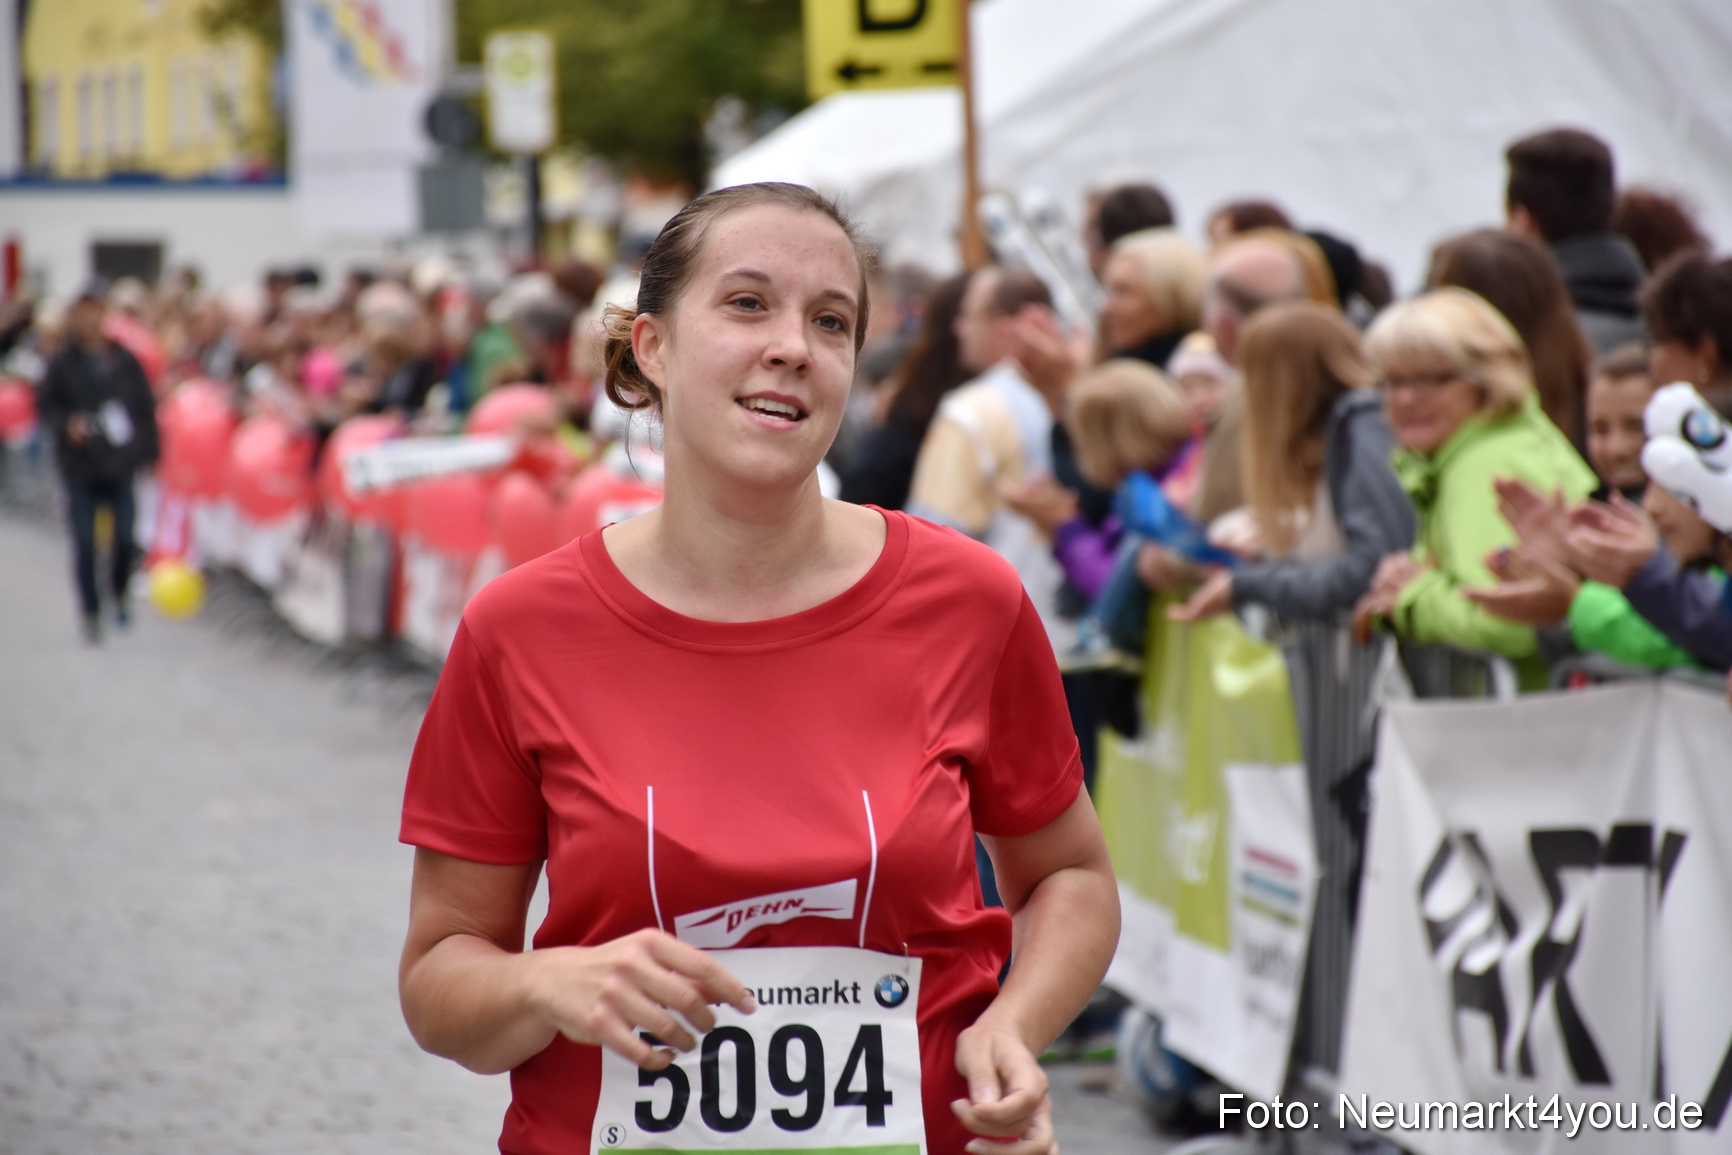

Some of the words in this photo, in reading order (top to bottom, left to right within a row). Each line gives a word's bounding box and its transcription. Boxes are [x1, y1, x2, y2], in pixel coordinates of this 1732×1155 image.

[727, 897, 804, 934] DEHN
[714, 979, 861, 1007] umarkt
[634, 1023, 893, 1133] 5094
[606, 1126, 619, 1145] S
